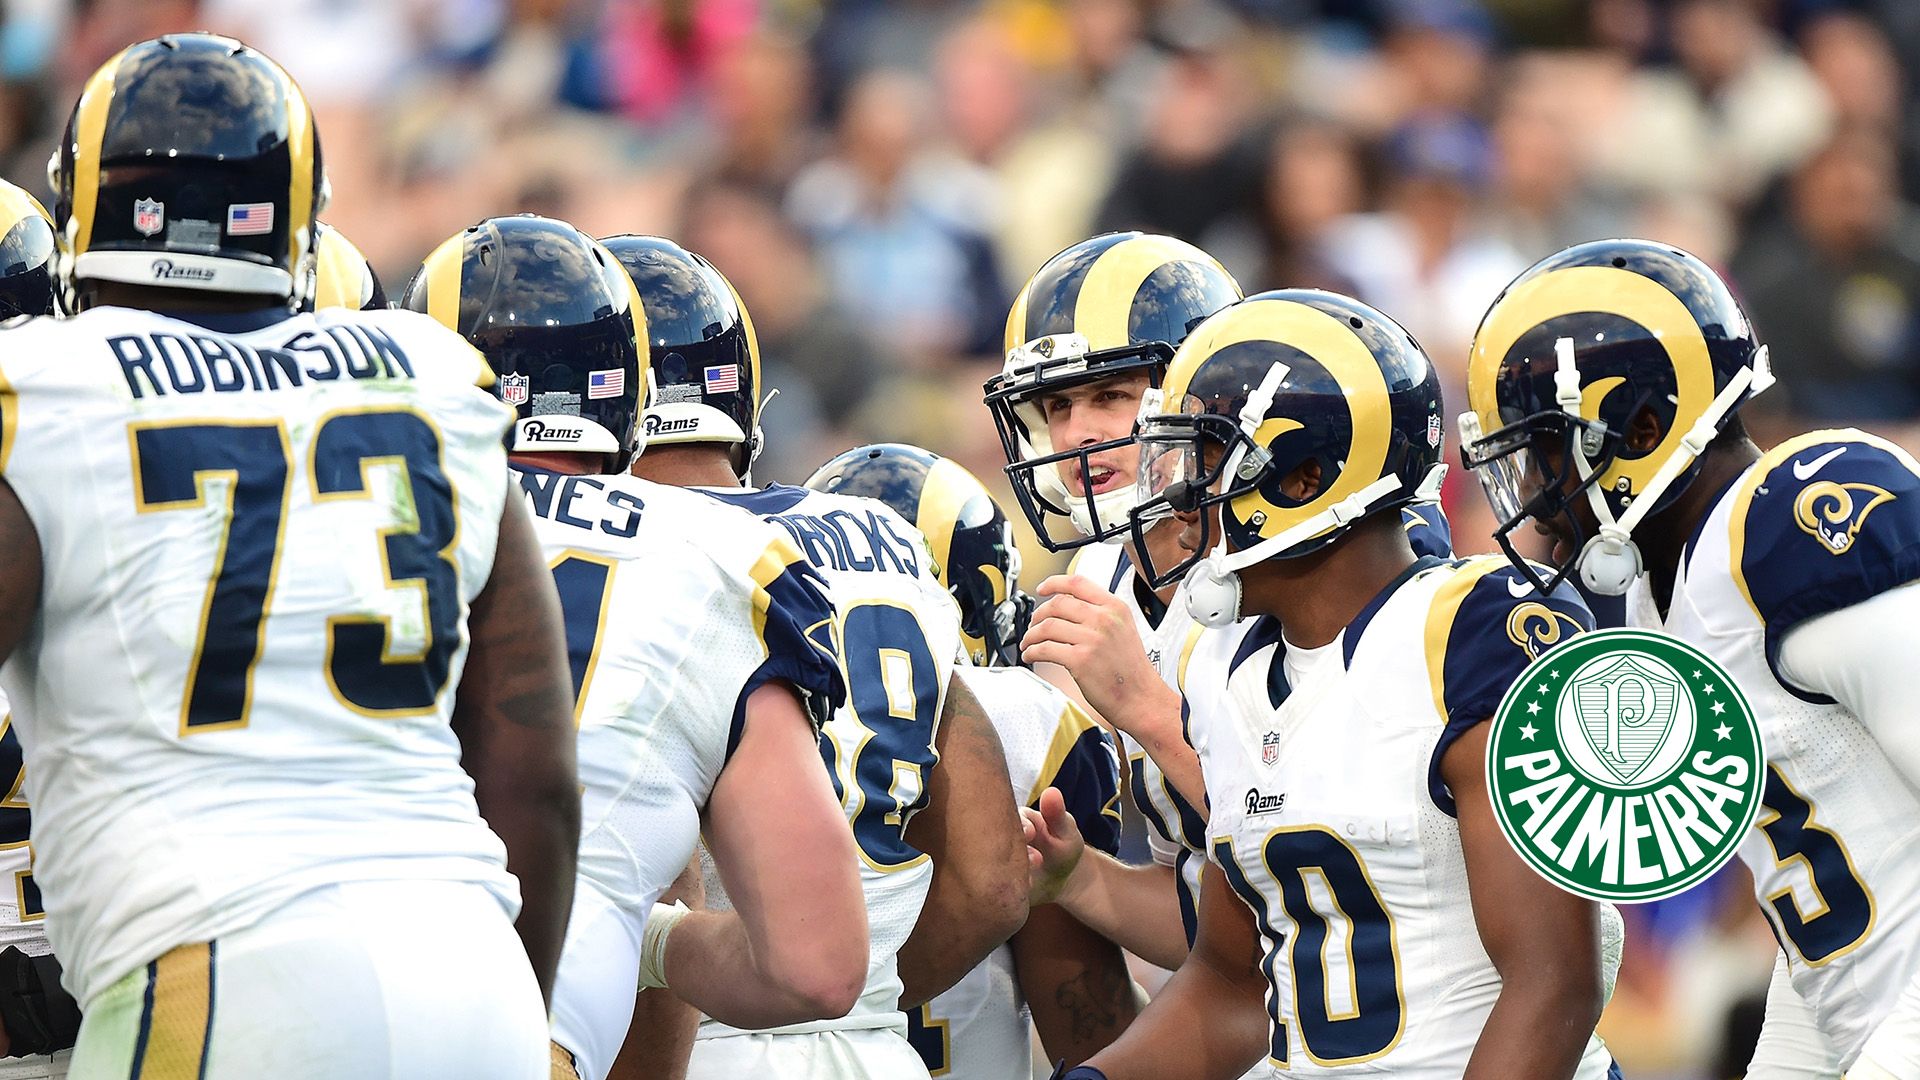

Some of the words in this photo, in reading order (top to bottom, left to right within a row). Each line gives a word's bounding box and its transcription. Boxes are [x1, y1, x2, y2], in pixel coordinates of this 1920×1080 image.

[152, 259, 214, 281] Rams
[106, 325, 416, 399] ROBINSON
[505, 387, 524, 401] NFL
[523, 420, 583, 442] Rams
[642, 414, 699, 436] Rams
[127, 404, 462, 738] 73
[819, 598, 941, 873] 8
[1245, 787, 1285, 815] Rams
[1755, 762, 1878, 970] 3
[1211, 823, 1406, 1070] 10
